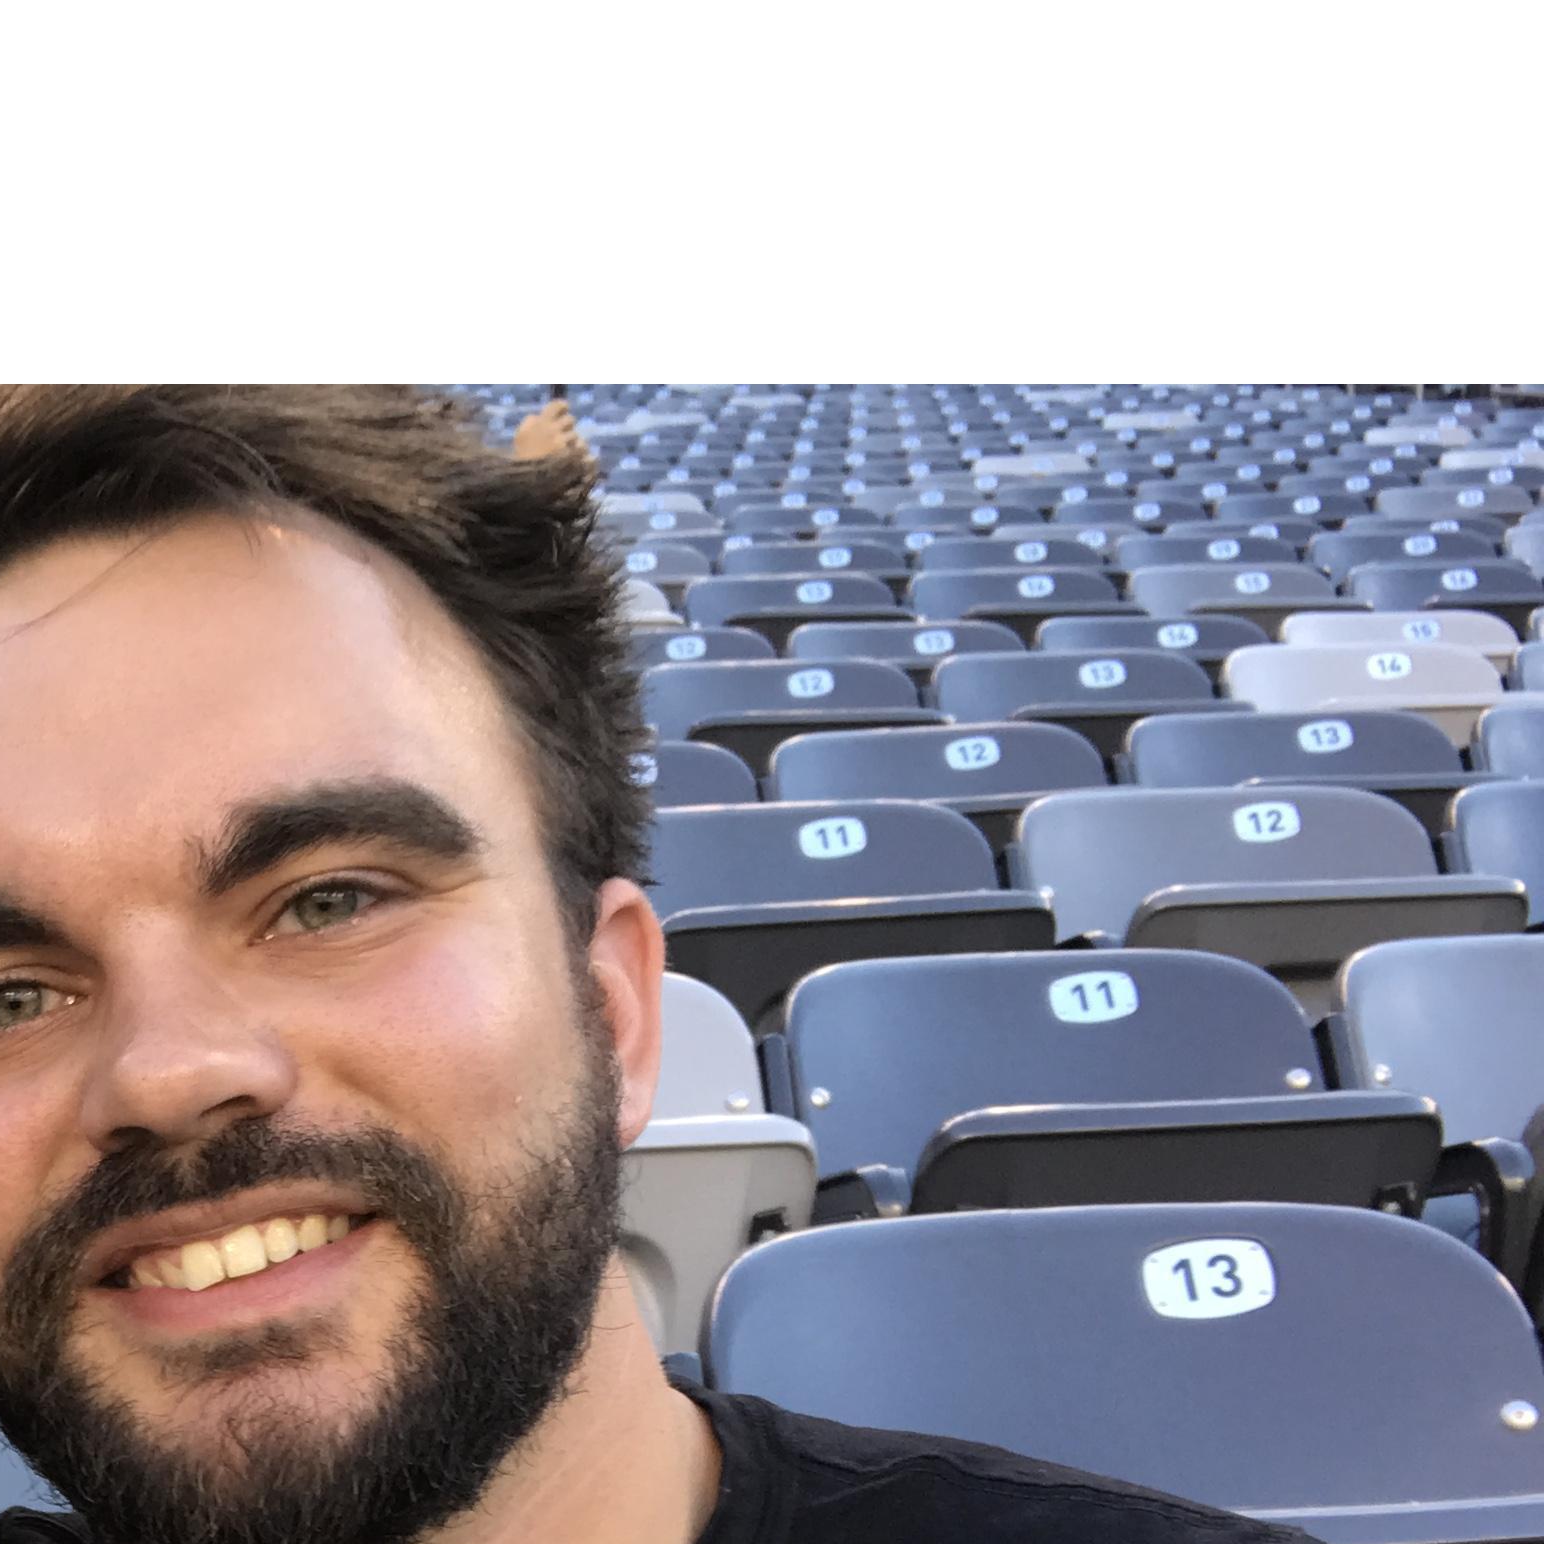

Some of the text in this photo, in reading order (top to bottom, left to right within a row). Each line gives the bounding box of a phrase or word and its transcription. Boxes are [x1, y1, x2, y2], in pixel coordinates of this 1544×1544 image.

[799, 676, 822, 692] 12
[1091, 665, 1115, 682] 13
[1310, 727, 1340, 746] 13
[958, 743, 986, 763] 12
[1248, 809, 1284, 834] 12
[817, 825, 849, 849] 11
[1071, 980, 1115, 1012] 11
[1172, 1253, 1243, 1302] 13
